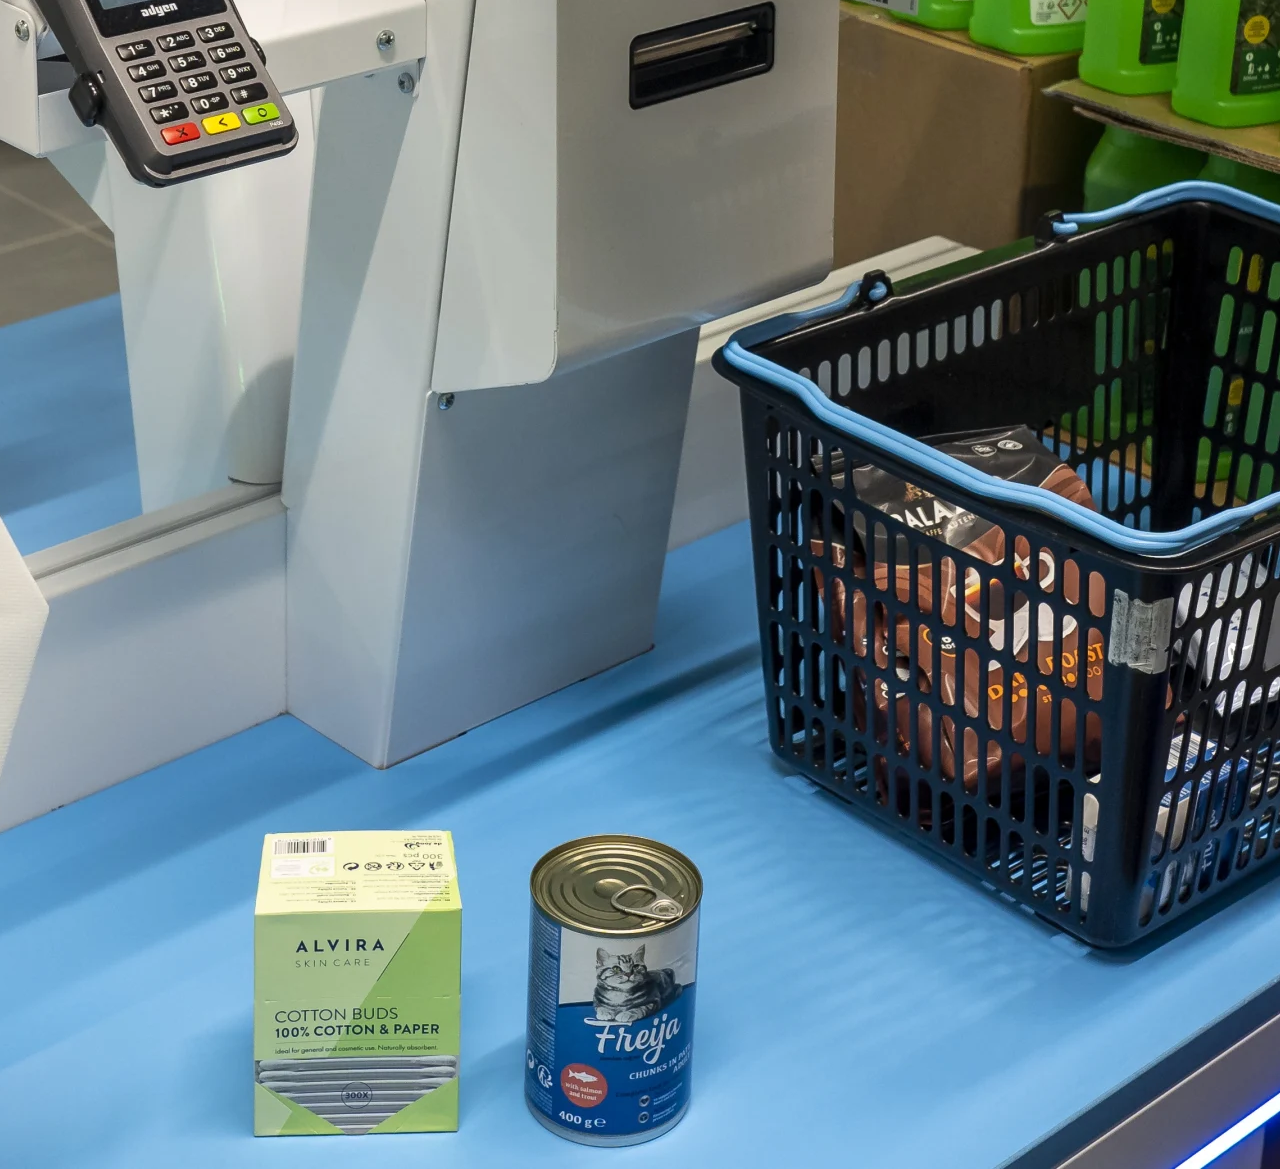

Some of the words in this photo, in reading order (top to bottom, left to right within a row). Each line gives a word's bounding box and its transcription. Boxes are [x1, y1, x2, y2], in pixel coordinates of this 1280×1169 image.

[140, 2, 178, 18] adyen
[205, 28, 214, 38] 3
[167, 37, 176, 47] 2
[176, 34, 190, 42] ABC
[128, 45, 136, 56] 1
[217, 48, 226, 58] 6
[178, 57, 186, 67] 5
[138, 66, 147, 77] 4
[228, 68, 237, 79] 9
[188, 77, 197, 88] 8
[148, 87, 156, 98] 7
[200, 99, 210, 109] 0
[295, 938, 385, 953] ALVIRA
[295, 959, 327, 968] SKIN
[333, 958, 370, 967] CARE
[274, 1008, 346, 1023] COTTON
[352, 1007, 399, 1020] BUDS
[275, 1026, 310, 1039] 100%
[314, 1024, 374, 1037] COTTON
[379, 1025, 389, 1035] &
[394, 1023, 440, 1035] PAPER
[584, 1013, 682, 1065] Freija
[301, 1047, 324, 1055] general
[338, 1045, 364, 1053] cosmetic
[378, 1044, 406, 1053] Naturally
[406, 1043, 439, 1052] absorbent.
[629, 1063, 667, 1080] CHUNKS
[669, 1058, 677, 1068] IN
[565, 1081, 579, 1091] with
[579, 1086, 603, 1095] salmon
[345, 1091, 369, 1099] 300X
[569, 1090, 580, 1098] and
[581, 1092, 597, 1101] trout
[558, 1110, 582, 1125] 400
